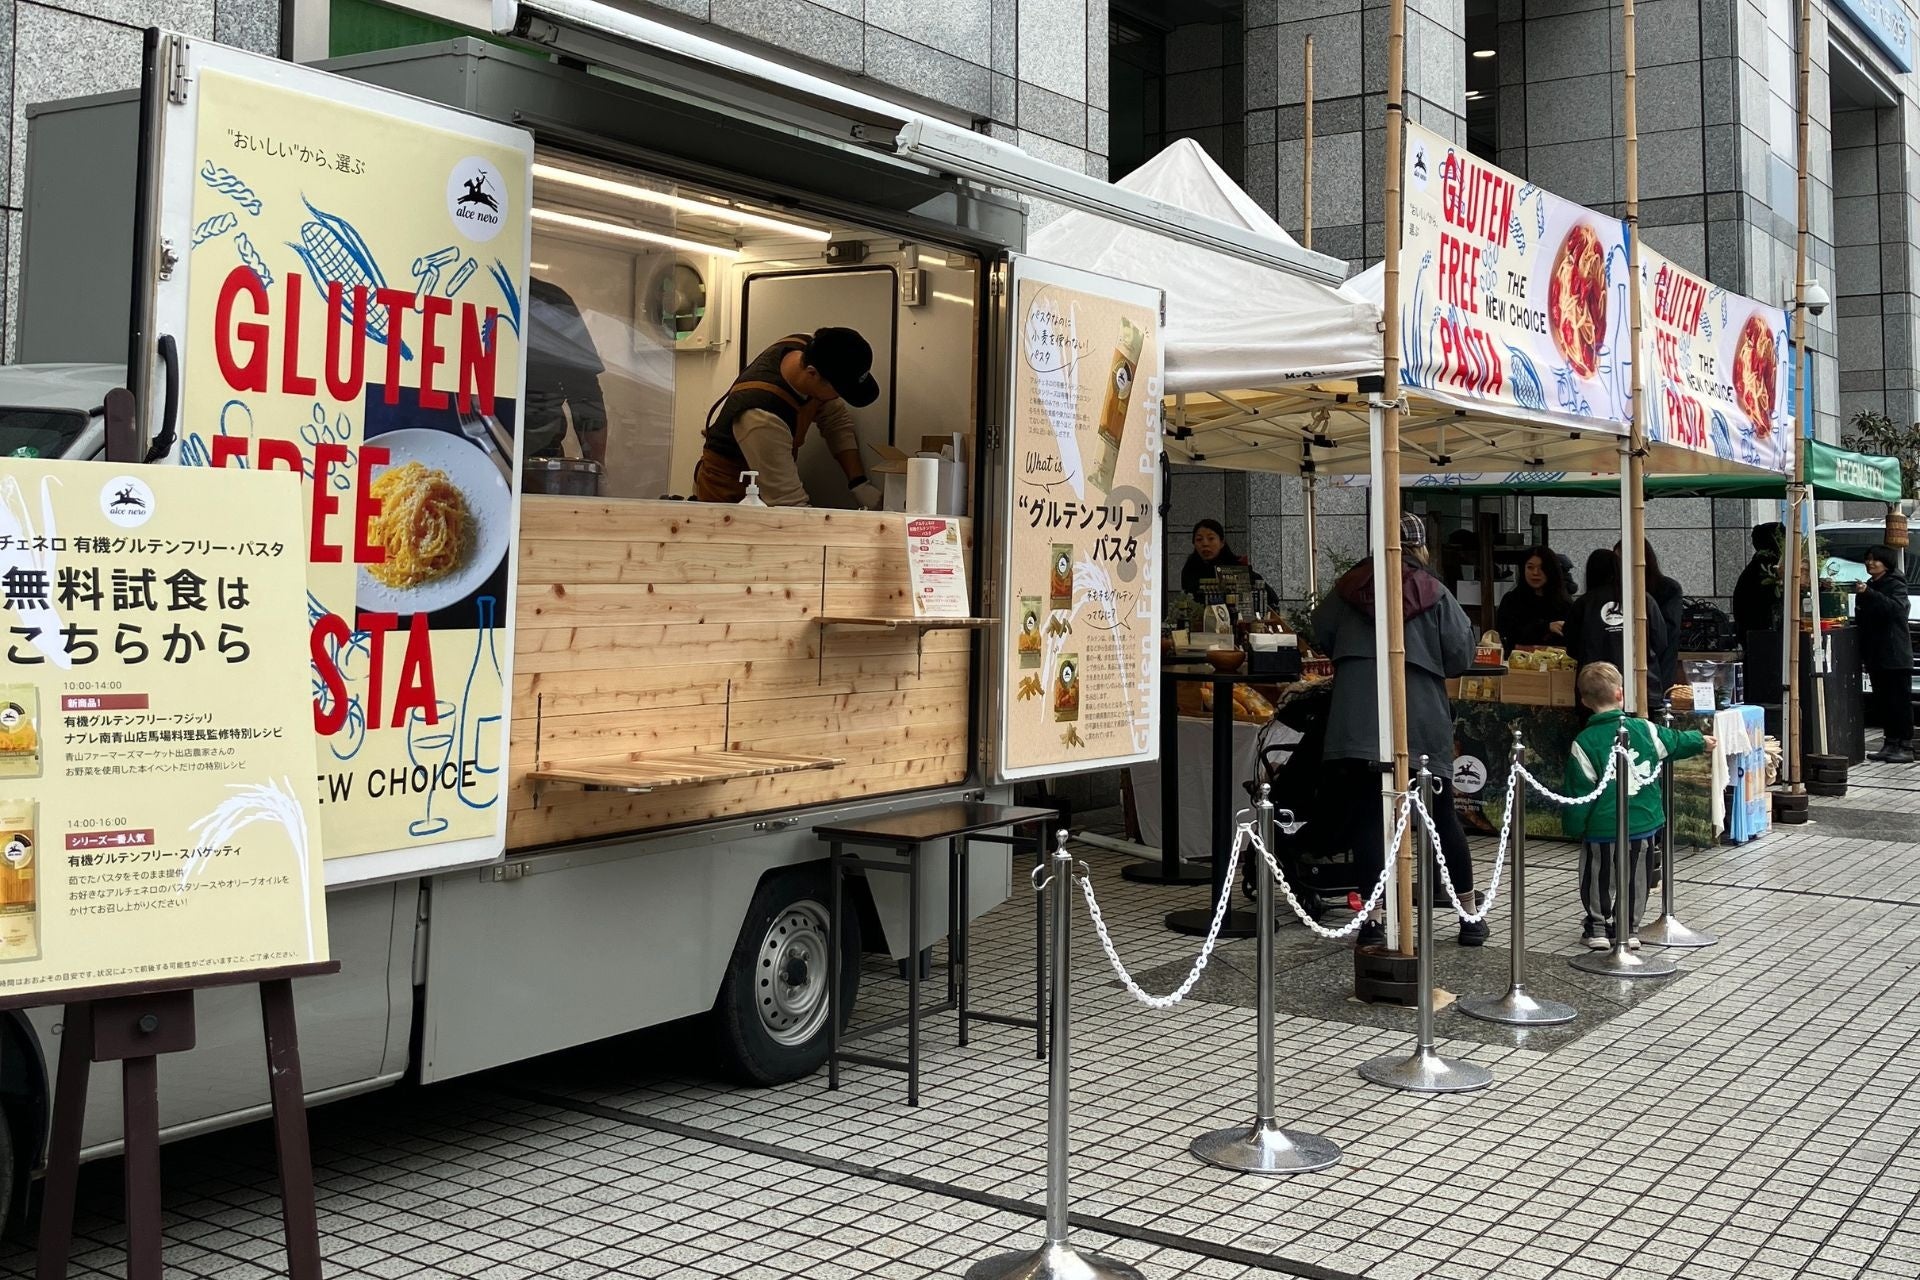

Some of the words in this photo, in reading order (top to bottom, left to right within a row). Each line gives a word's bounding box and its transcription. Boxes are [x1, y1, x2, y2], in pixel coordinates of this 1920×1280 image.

[1443, 152, 1515, 249] GLUTEN
[456, 206, 475, 220] alce
[477, 211, 498, 225] nero
[1439, 232, 1480, 314] FREE
[1508, 270, 1527, 299] THE
[1654, 264, 1707, 337] GLUTEN
[1031, 310, 1071, 327] パスタなのに
[1486, 294, 1506, 321] NEW
[1509, 304, 1547, 334] CHOICE
[215, 265, 499, 417] GLUTEN
[1031, 349, 1051, 365] パスタ
[1439, 316, 1502, 396] PASTA
[1699, 354, 1714, 376] THE
[1686, 373, 1704, 393] NEW
[1704, 379, 1733, 403] CHOICE
[1666, 388, 1708, 449] PASTA
[1026, 451, 1052, 474] What
[1054, 456, 1064, 474] is
[110, 507, 126, 516] alce
[128, 507, 147, 516] nero
[73, 536, 285, 557] 有機グルテンフリー・パスタ
[1092, 535, 1138, 563] パスタ
[1, 566, 251, 612] 無料試食は
[1087, 588, 1134, 603] そもそもグルテン
[6, 622, 251, 665] こちらから
[63, 680, 123, 691] 10:00-14:00
[67, 698, 101, 709] 新商品!
[63, 713, 213, 728] 有機グルテンフリー・フジッリ
[368, 759, 478, 797] CHOICE
[67, 817, 127, 828] 14:00-16:00
[71, 833, 146, 847] シリーズ一番人気
[67, 846, 242, 868] 有機グルテンフリー・スパゲッティ
